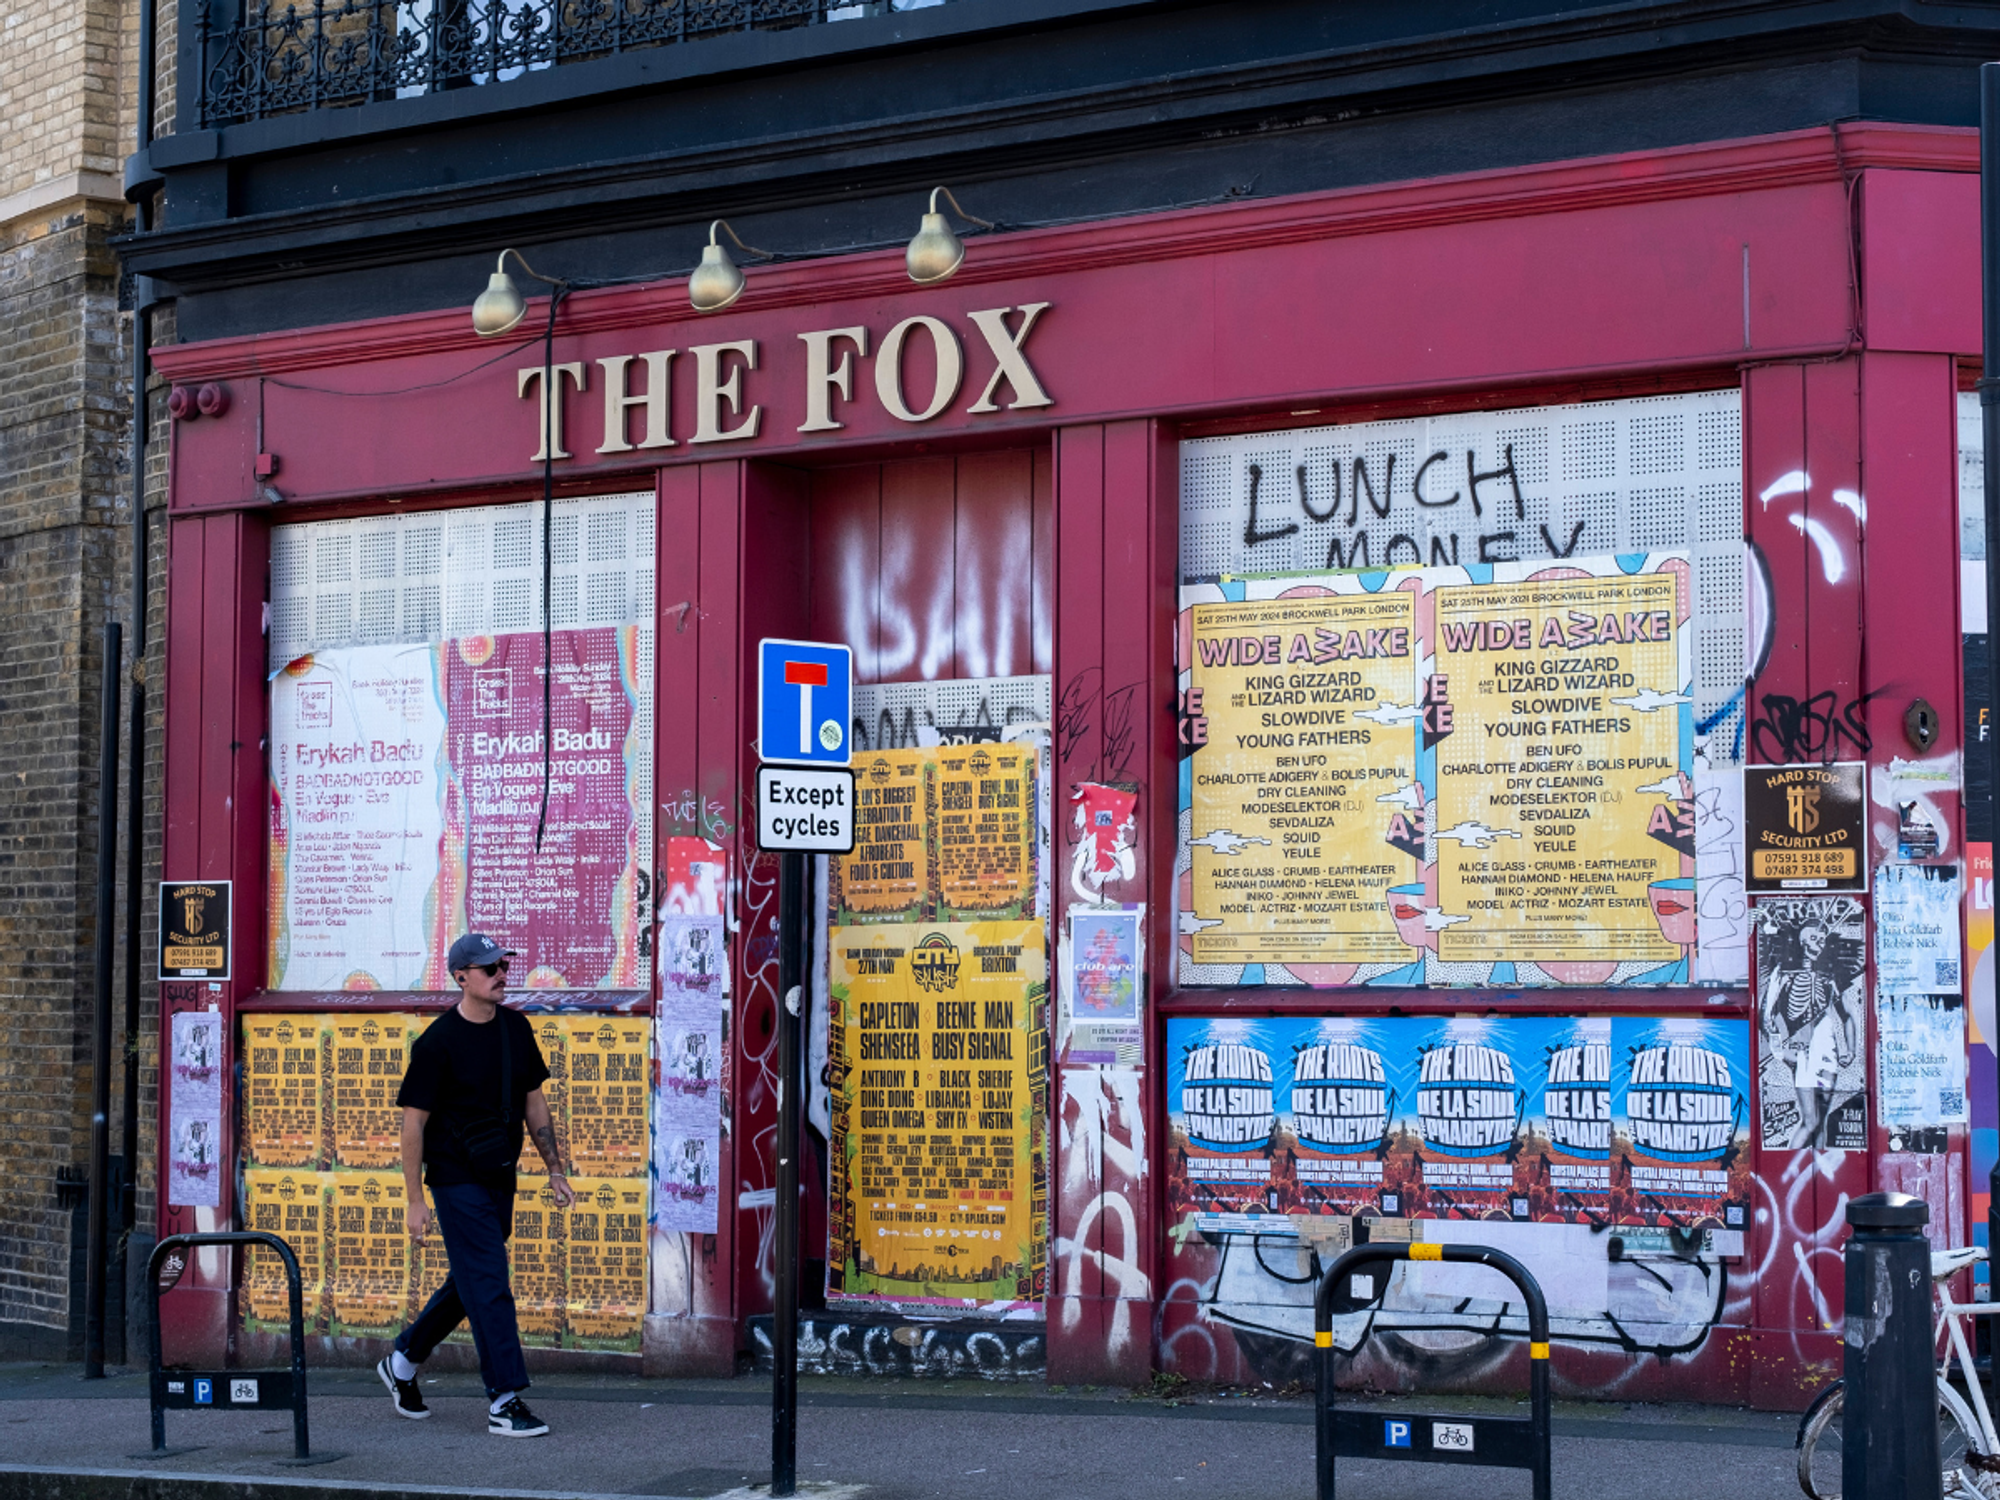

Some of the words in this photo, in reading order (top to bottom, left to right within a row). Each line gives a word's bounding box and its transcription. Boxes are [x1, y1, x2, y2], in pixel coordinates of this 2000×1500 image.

[518, 339, 762, 461] THE
[797, 302, 1054, 432] FOX
[1243, 444, 1524, 545] LUNCH
[1441, 598, 1458, 607] SAT
[1487, 596, 1507, 606] MAY
[1532, 590, 1595, 603] BROCKWELL
[1598, 588, 1624, 598] PARK
[1627, 586, 1671, 597] LONDON
[1197, 616, 1213, 624] SAT
[1215, 615, 1237, 624] 25TH
[1239, 614, 1257, 622] MAY
[1282, 609, 1339, 620] BROCKWELL
[1342, 607, 1367, 616] PARK
[1369, 604, 1409, 614] LONDON
[1441, 619, 1531, 652] WIDE
[1540, 610, 1671, 650] AWAKE
[1198, 636, 1281, 666] WIDE
[1288, 627, 1409, 665] AWAKE
[1495, 661, 1535, 676] KING
[1541, 657, 1618, 674] GIZZARD
[1246, 676, 1284, 690] KING
[1289, 672, 1361, 688] GIZZARD
[1498, 676, 1560, 693] LIZARD
[1565, 673, 1634, 690] WIZARD
[1249, 691, 1307, 706] LIZARD
[1311, 687, 1376, 702] WIZARD
[1512, 697, 1601, 714] SLOWDIVE
[1262, 711, 1345, 727] SLOWDIVE
[1485, 722, 1546, 737] YOUNG
[1552, 718, 1631, 735] FATHERS
[554, 727, 611, 751] Badu
[1237, 734, 1294, 749] YOUNG
[1299, 730, 1371, 746] FATHERS
[297, 742, 365, 768] Erykah
[1527, 746, 1552, 756] BEN
[1556, 744, 1582, 755] UFO
[1277, 756, 1300, 767] BEN
[1302, 755, 1327, 765] UFO
[1442, 763, 1516, 775] CHARLOTTE
[1519, 761, 1574, 772] ADIGERY
[1587, 759, 1624, 771] BOLIS
[1629, 757, 1672, 769] PUPUL
[1198, 774, 1266, 785] CHARLOTTE
[1269, 771, 1318, 783] ADIGERY
[1332, 769, 1366, 780] BOLIS
[1369, 768, 1409, 779] PUPUL
[1507, 778, 1532, 789] DRY
[1536, 776, 1603, 788] CLEANING
[1766, 770, 1804, 788] HARD
[1806, 770, 1840, 784] STOP
[769, 780, 844, 809] Except
[1258, 788, 1281, 798] DRY
[1285, 786, 1346, 797] CLEANING
[1490, 792, 1596, 805] MODESELEKTOR
[1242, 802, 1341, 814] MODESELEKTOR
[1519, 809, 1590, 821] SEVDALIZA
[772, 813, 840, 839] cycles
[1270, 817, 1334, 828] SEVDALIZA
[1534, 825, 1575, 836] SQUID
[1283, 832, 1320, 843] SQUID
[1534, 841, 1576, 852] YEULE
[1761, 830, 1821, 848] SECURITY
[1825, 829, 1848, 845] LTD
[860, 844, 904, 862] AFROBEATS
[1282, 848, 1321, 858] YEULE
[1765, 853, 1798, 863] 07591
[1802, 853, 1820, 863] 918
[881, 862, 914, 880] CULTURE
[1212, 868, 1239, 877] ALICE
[1243, 867, 1274, 877] GLASS
[1283, 866, 1320, 876] CRUMB
[1329, 865, 1395, 875] EARTHEATER
[1765, 865, 1798, 875] 07487
[1802, 865, 1820, 874] 374
[1215, 881, 1257, 890] HANNAH
[1259, 879, 1306, 889] DIAMOND
[1315, 879, 1355, 888] HELENA
[1359, 877, 1392, 887] HAUFF
[173, 887, 196, 899] HARD
[197, 887, 216, 898] STOP
[1247, 892, 1273, 900] INIKO
[1282, 891, 1323, 900] JOHNNY
[1326, 890, 1359, 900] JEWEL
[1304, 903, 1346, 912] MOZART
[1350, 902, 1388, 911] ESTATE
[169, 931, 204, 945] SECURITY
[205, 931, 220, 943] LTD
[1917, 937, 1938, 948] Nick
[1075, 962, 1105, 972] club
[860, 1002, 919, 1029] CAPLETON
[937, 1002, 976, 1029] BEENIE
[985, 1002, 1013, 1030] MAN
[860, 1033, 920, 1060] SHENSEEA
[932, 1032, 966, 1060] BUSY
[969, 1033, 1013, 1060] SIGNAL
[1185, 1047, 1217, 1082] THE
[1217, 1044, 1273, 1082] ROOTS
[1294, 1047, 1326, 1082] THE
[1327, 1044, 1386, 1083] ROOTS
[1630, 1047, 1667, 1085] THE
[1667, 1046, 1732, 1088] ROOTS
[860, 1070, 906, 1088] ANTHONY
[913, 1071, 919, 1088] B
[940, 1071, 971, 1087] BLACK
[978, 1071, 1013, 1088] SHERIF
[1921, 1067, 1942, 1078] Nick
[861, 1090, 884, 1108] DING
[888, 1091, 914, 1108] DONG
[926, 1091, 971, 1109] LIBIANCA
[983, 1091, 1013, 1109] LOJAY
[1182, 1088, 1205, 1115] DE
[1206, 1087, 1228, 1115] LA
[1228, 1087, 1274, 1115] SOUL
[1291, 1088, 1315, 1115] DE
[1316, 1088, 1339, 1115] LA
[1339, 1088, 1386, 1115] SOUL
[1627, 1091, 1652, 1119] DE
[1654, 1092, 1680, 1121] LA
[1680, 1093, 1732, 1122] SOUL
[861, 1111, 889, 1129] QUEEN
[892, 1111, 925, 1129] OMEGA
[936, 1112, 954, 1129] SHY
[958, 1112, 967, 1129] FX
[978, 1112, 1013, 1129] WSTRN
[197, 1381, 210, 1401] P
[1391, 1423, 1408, 1445] P
